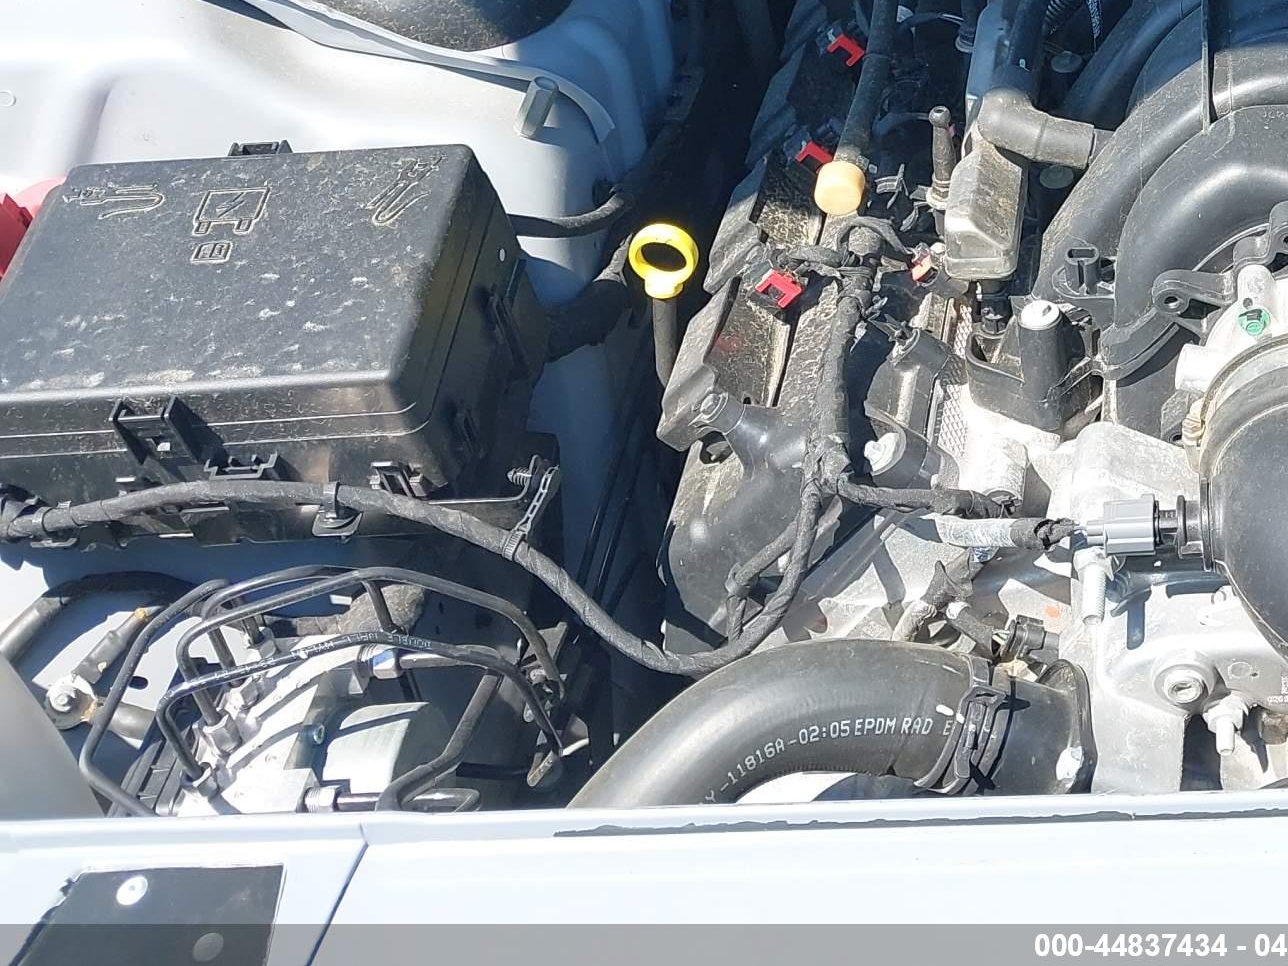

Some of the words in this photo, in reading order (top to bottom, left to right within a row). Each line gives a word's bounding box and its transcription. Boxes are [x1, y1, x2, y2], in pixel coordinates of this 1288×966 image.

[387, 632, 432, 650] DOUBLE
[699, 719, 851, 804] Y-11816A-02:05
[854, 717, 897, 736] EPDM
[901, 717, 934, 736] RAD
